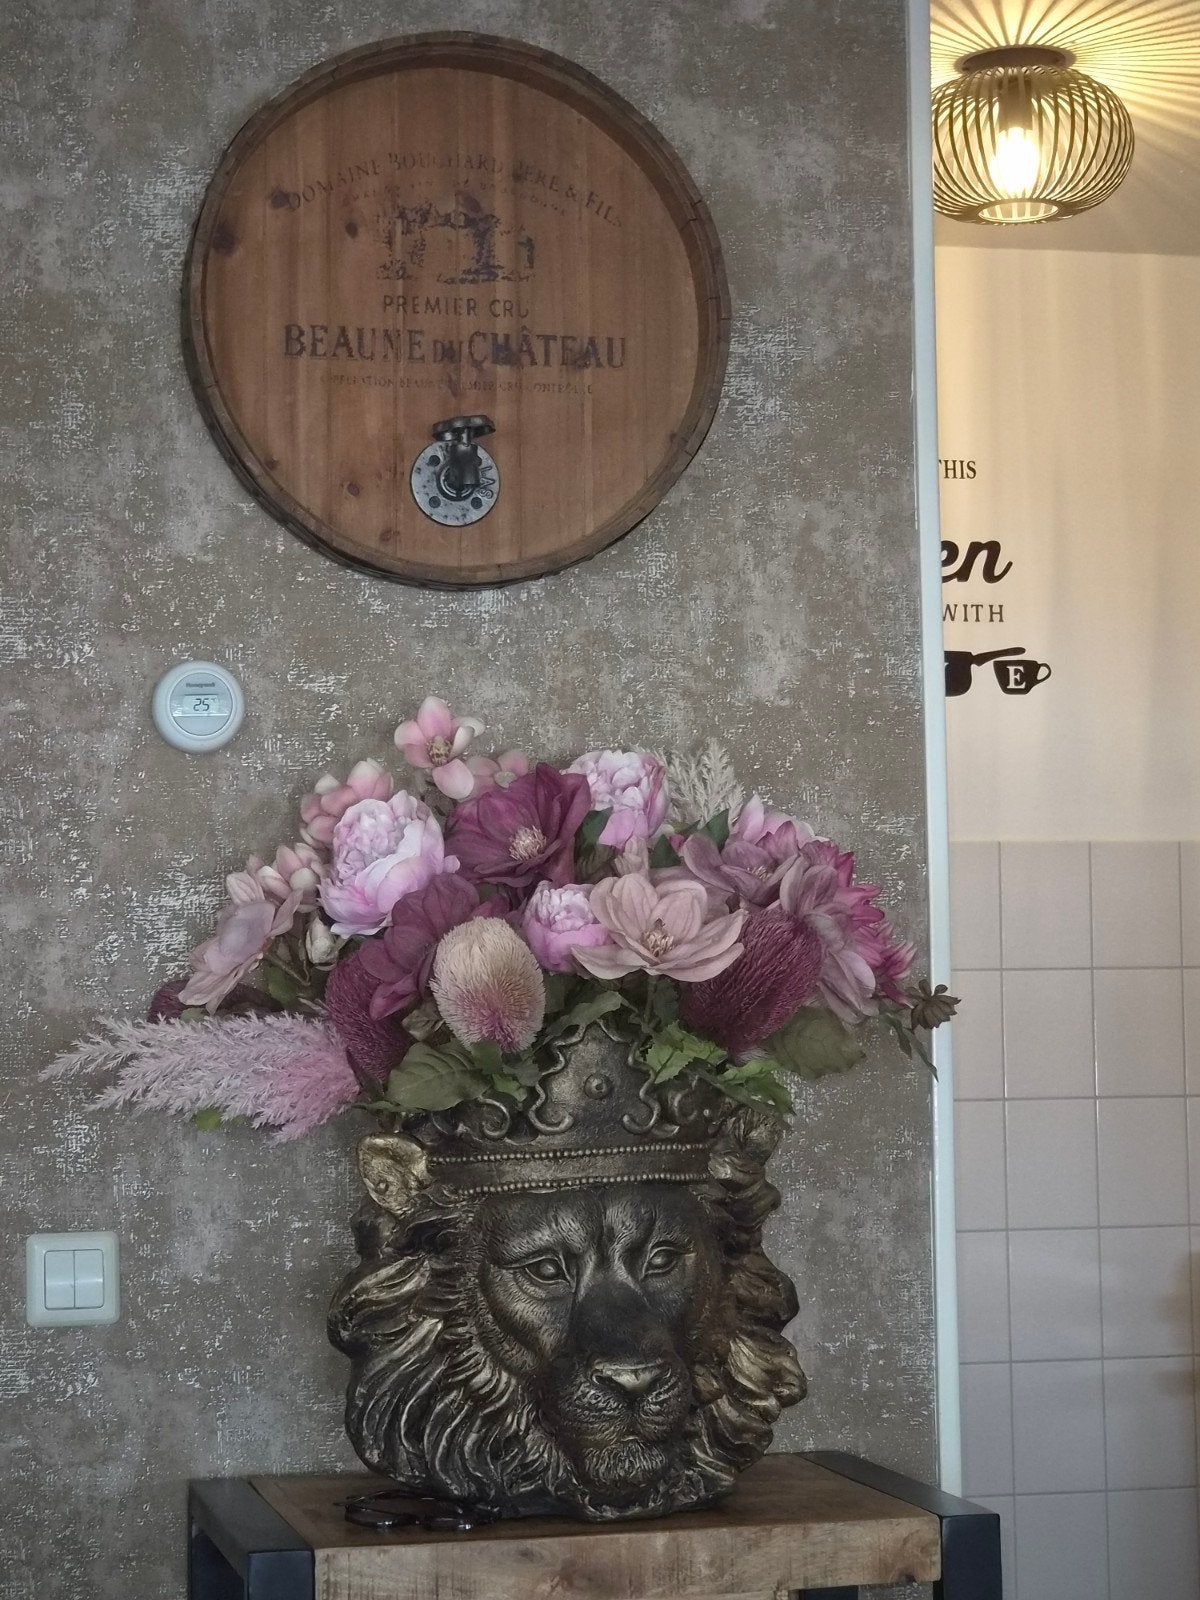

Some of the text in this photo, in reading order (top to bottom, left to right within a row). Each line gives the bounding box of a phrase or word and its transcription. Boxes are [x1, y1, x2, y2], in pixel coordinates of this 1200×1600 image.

[383, 294, 530, 319] PREMIER CRU
[283, 323, 426, 364] BEAUNE
[938, 460, 978, 480] HIS
[1006, 665, 1027, 690] E
[193, 697, 210, 712] 25
